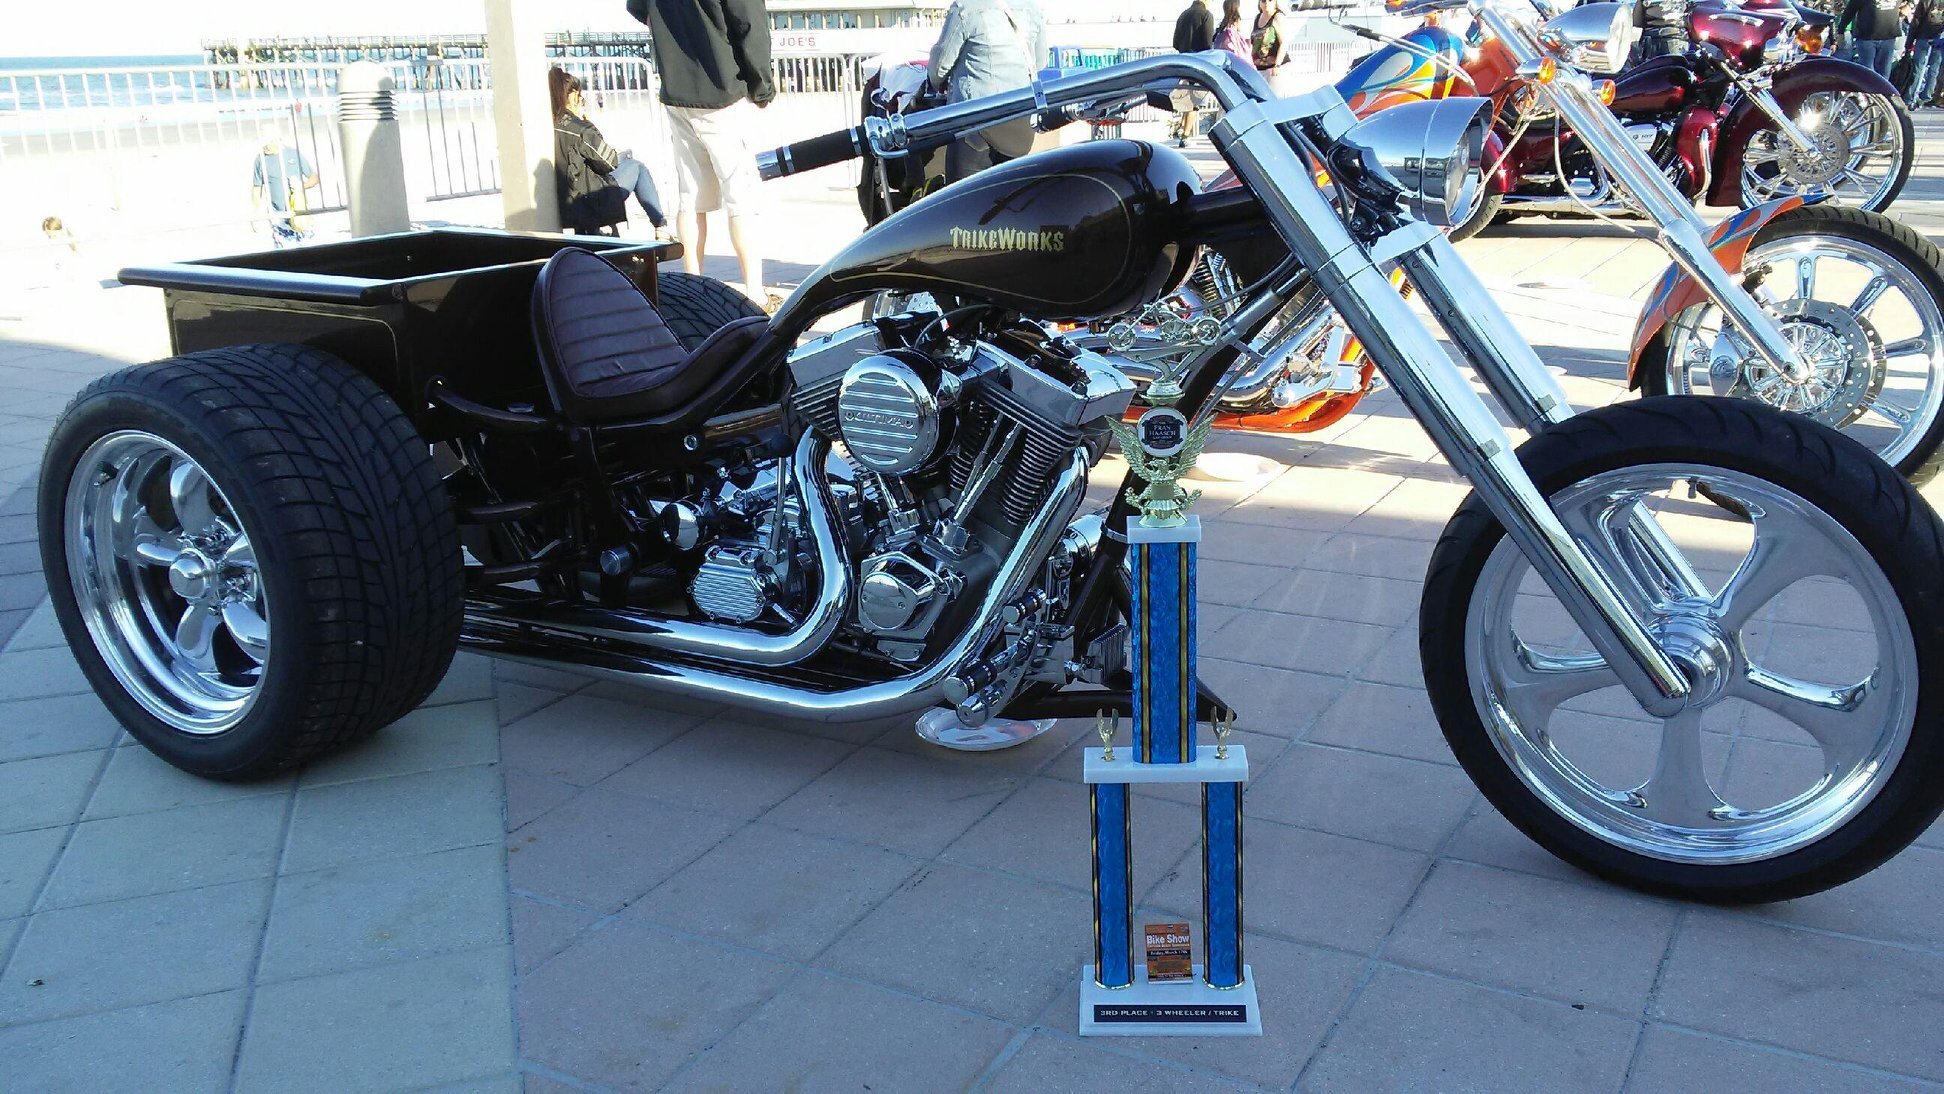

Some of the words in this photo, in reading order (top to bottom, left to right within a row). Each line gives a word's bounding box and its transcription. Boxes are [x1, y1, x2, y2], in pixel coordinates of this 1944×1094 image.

[780, 37, 816, 47] JOE'S
[1146, 934, 1166, 944] Bike
[1166, 933, 1190, 943] Show
